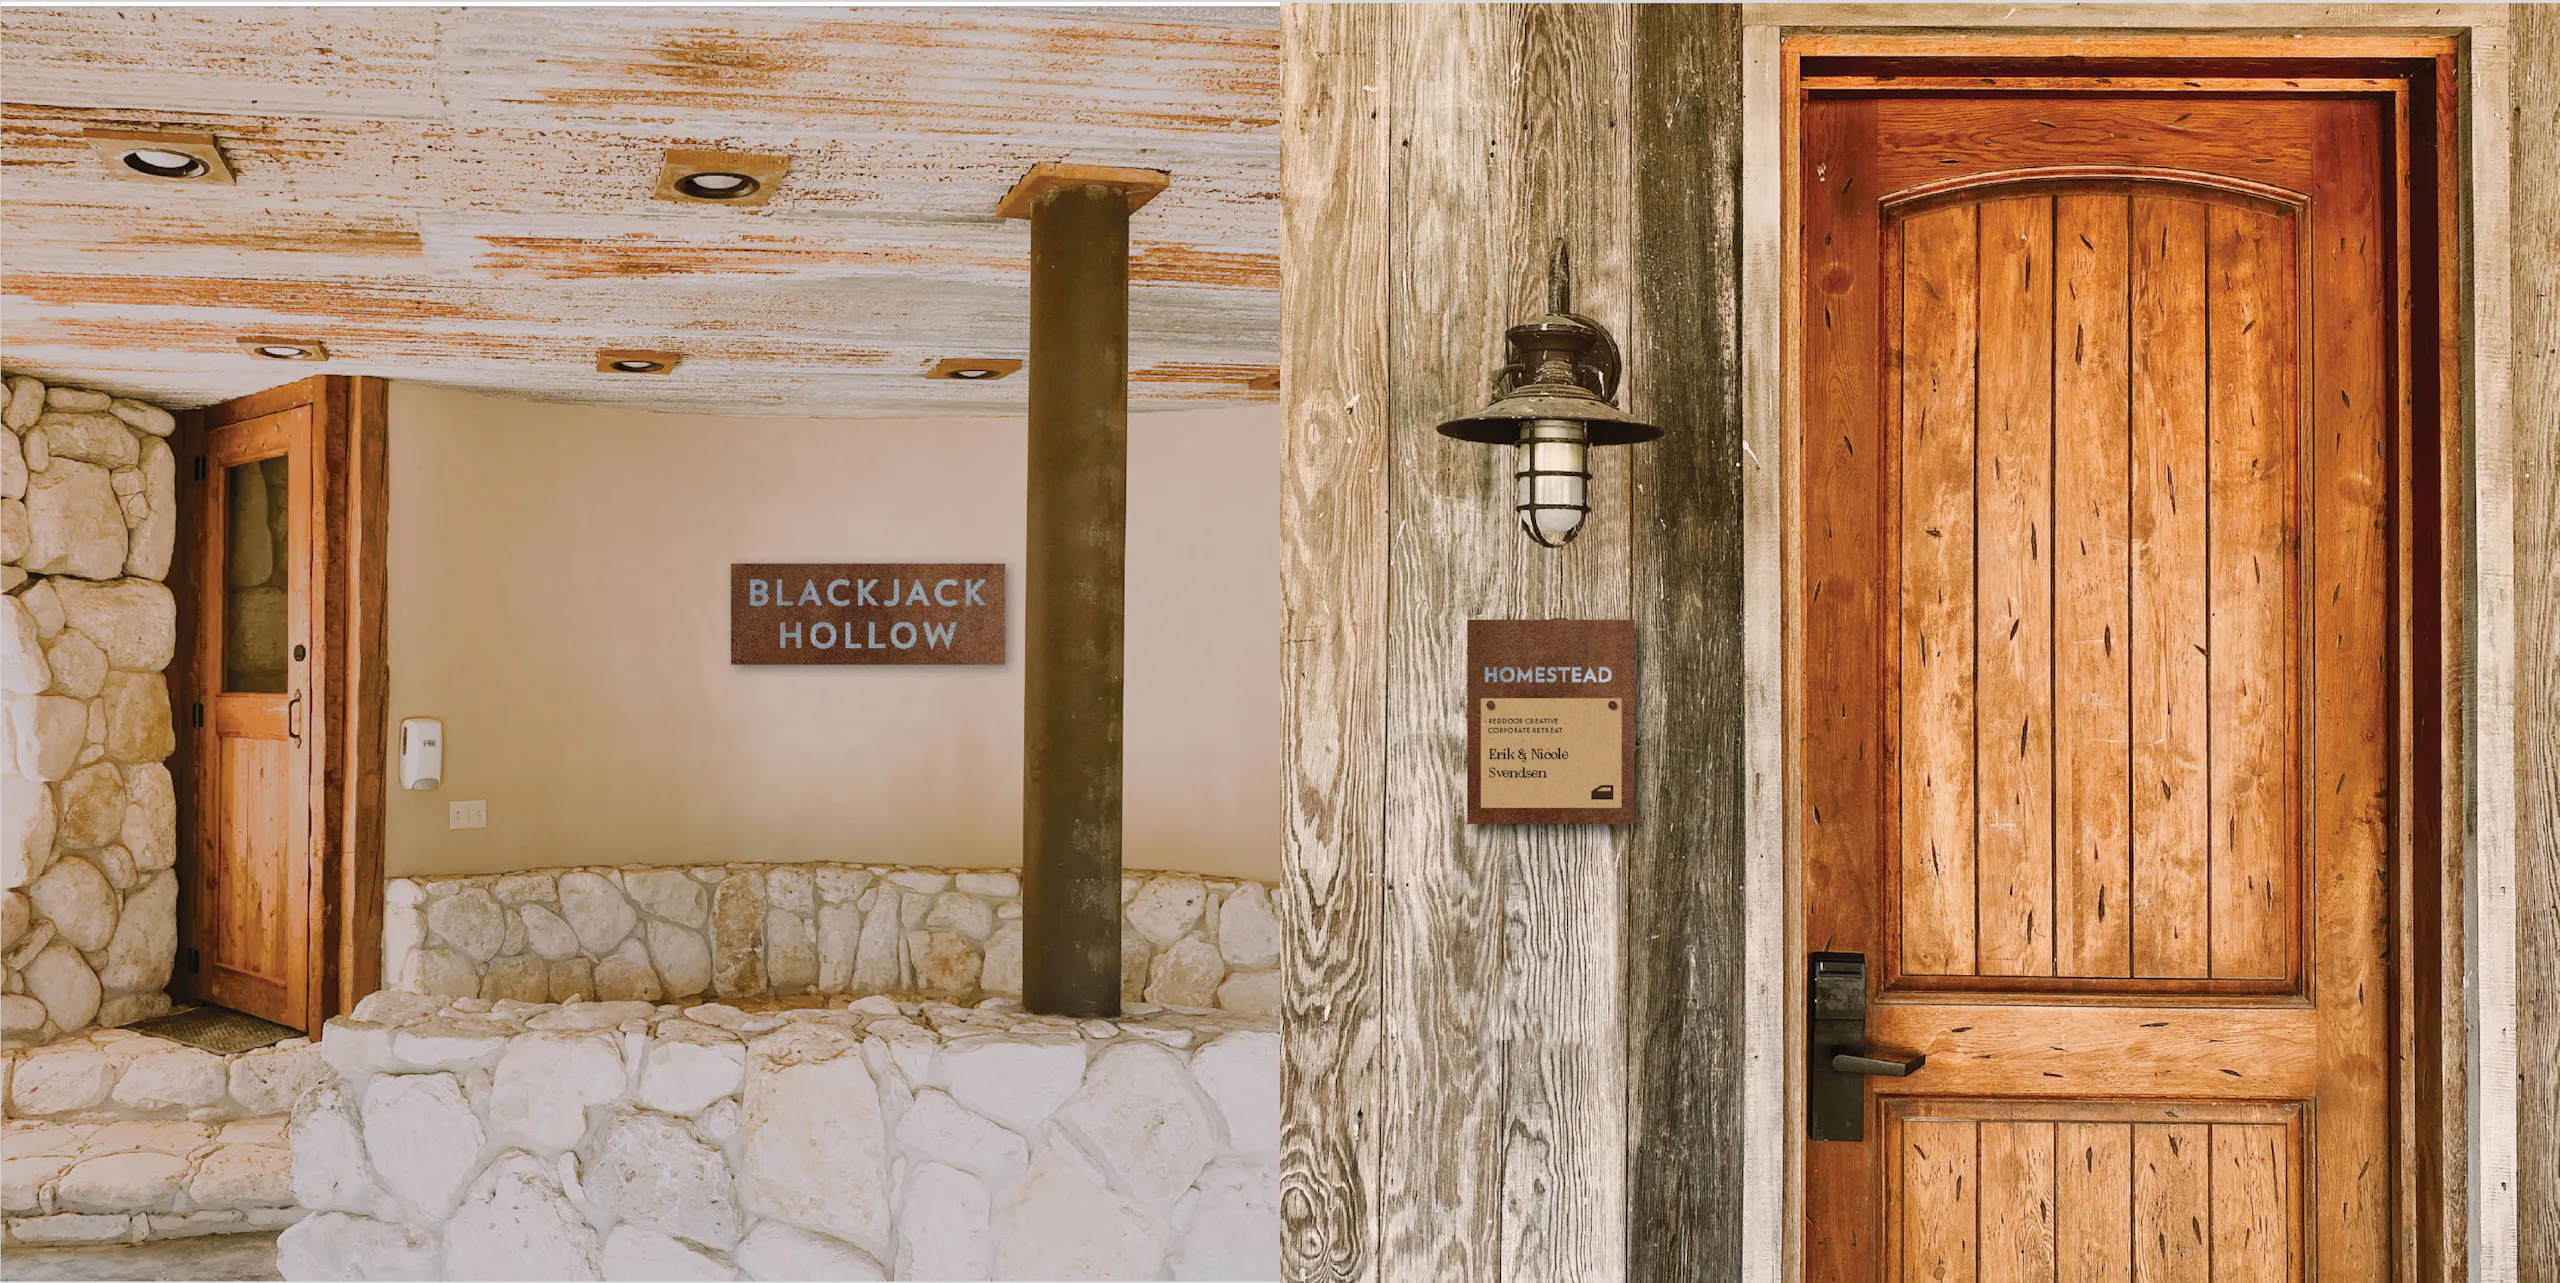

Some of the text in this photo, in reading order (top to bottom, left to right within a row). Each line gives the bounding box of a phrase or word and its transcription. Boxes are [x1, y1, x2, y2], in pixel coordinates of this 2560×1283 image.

[749, 578, 987, 607] BLACKJACK
[778, 621, 958, 650] HOLLOW
[1484, 666, 1613, 683] HOMESTEAD
[1489, 748, 1569, 762] Erik & Nicole
[1488, 766, 1547, 779] Svendsen
